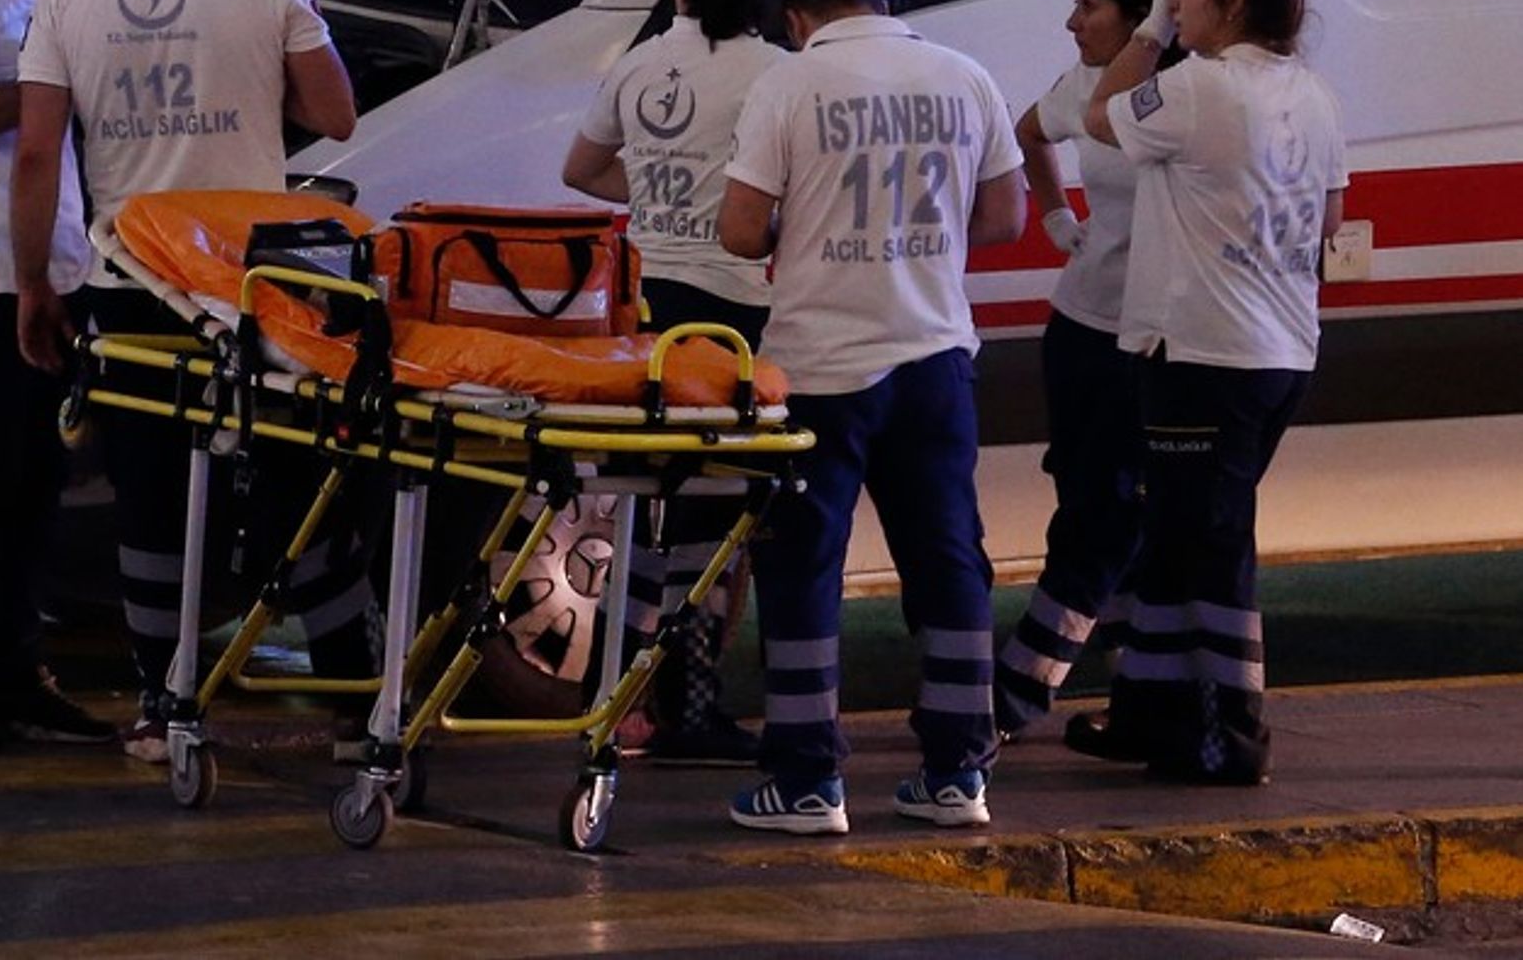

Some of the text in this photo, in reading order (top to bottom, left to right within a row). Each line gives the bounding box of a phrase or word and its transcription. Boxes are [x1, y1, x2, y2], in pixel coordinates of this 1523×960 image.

[114, 62, 195, 112] 112
[158, 108, 240, 137] SAĞLIK
[815, 93, 971, 154] İSTANBUL
[644, 162, 694, 208] 112
[842, 151, 948, 230] 112
